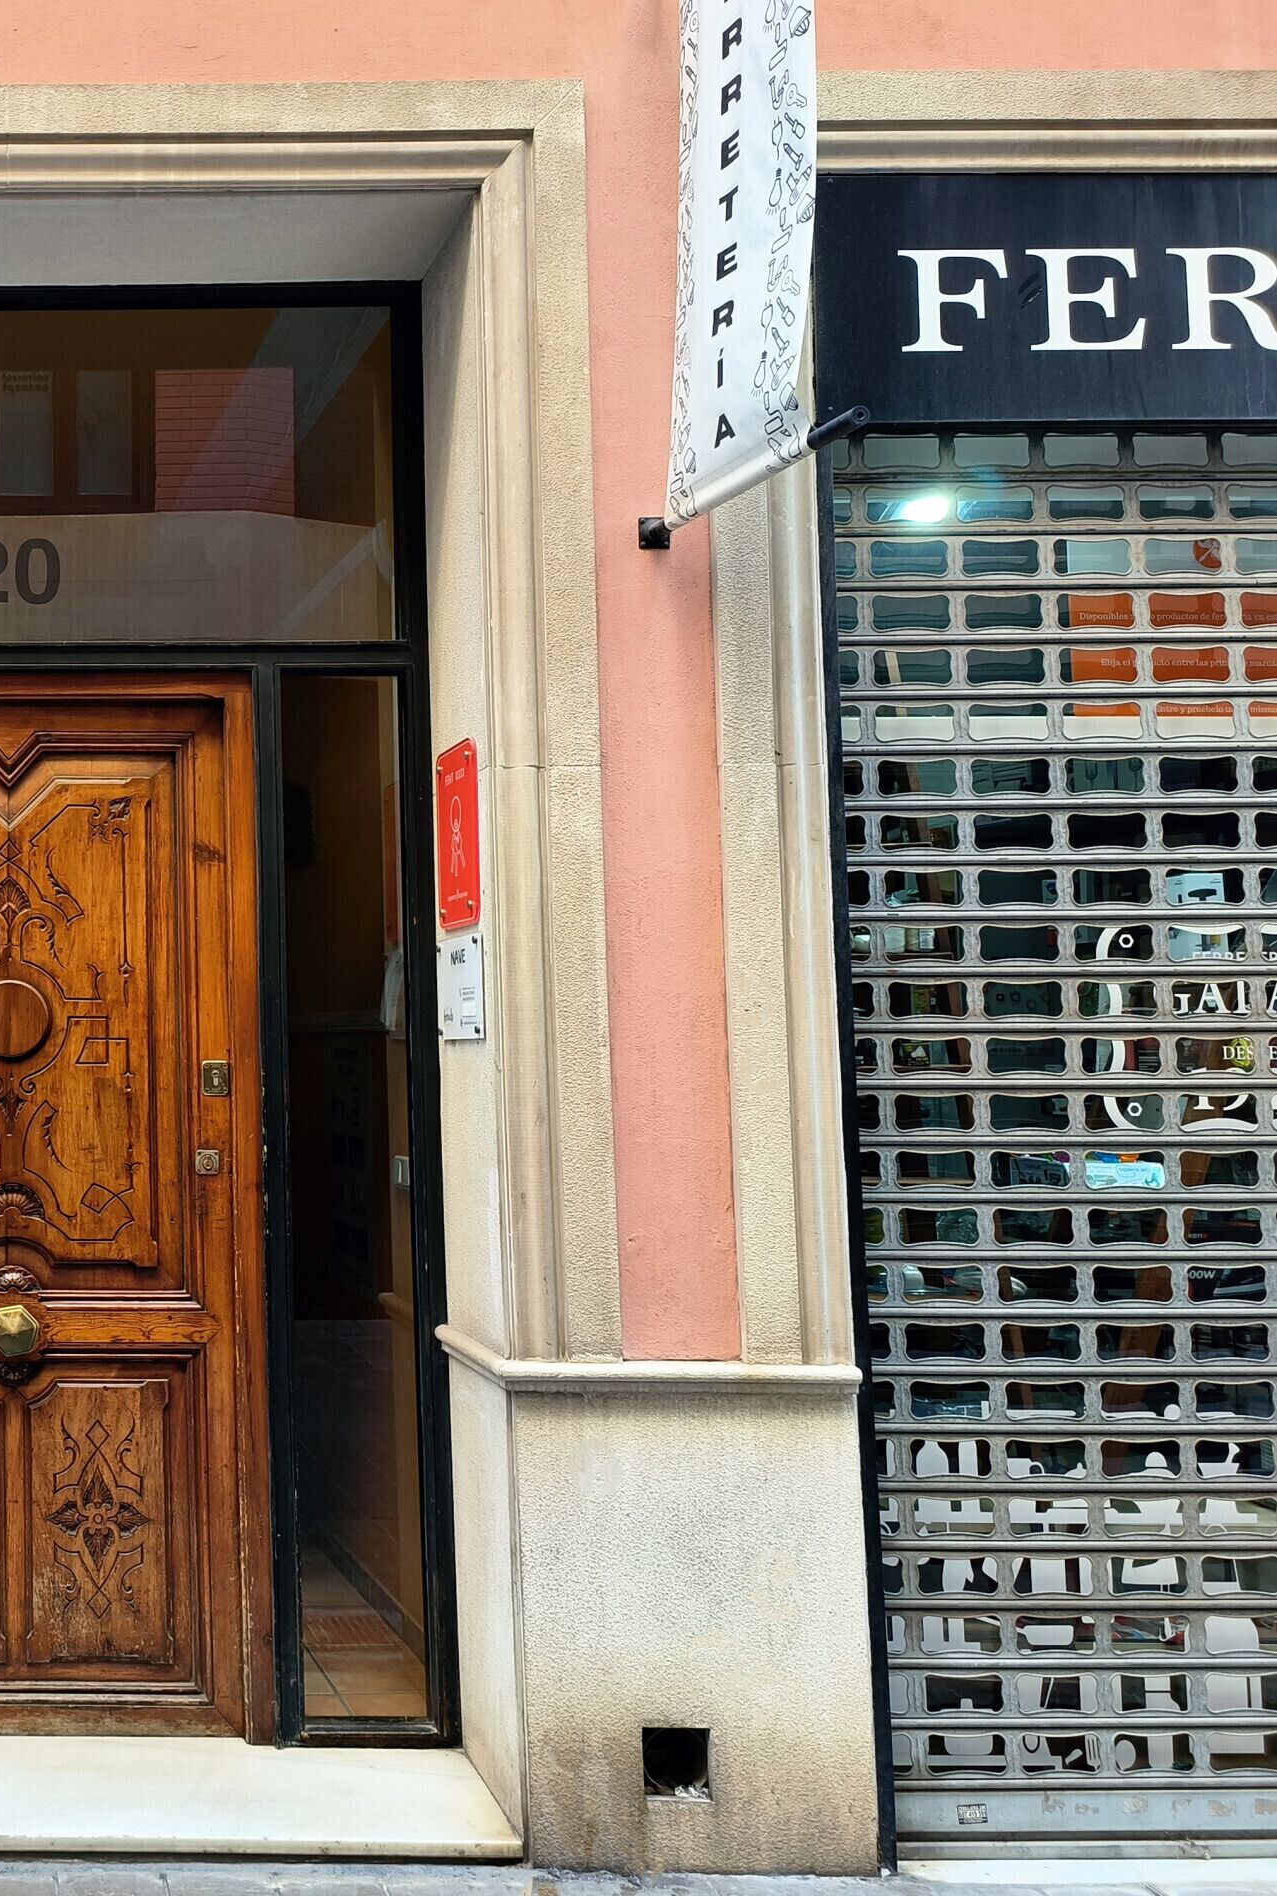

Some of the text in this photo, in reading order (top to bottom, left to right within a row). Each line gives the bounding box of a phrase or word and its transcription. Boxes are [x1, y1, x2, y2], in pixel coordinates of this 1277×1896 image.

[711, 0, 743, 450] RRETERÍA
[897, 247, 1277, 352] FER
[1079, 612, 1128, 622] Disponibles
[1156, 612, 1199, 621] productos
[1201, 612, 1210, 620] de
[1101, 658, 1122, 668] Elija
[1124, 658, 1131, 667] el
[1171, 659, 1195, 667] entre
[1197, 658, 1209, 667] las
[1179, 706, 1184, 714] y
